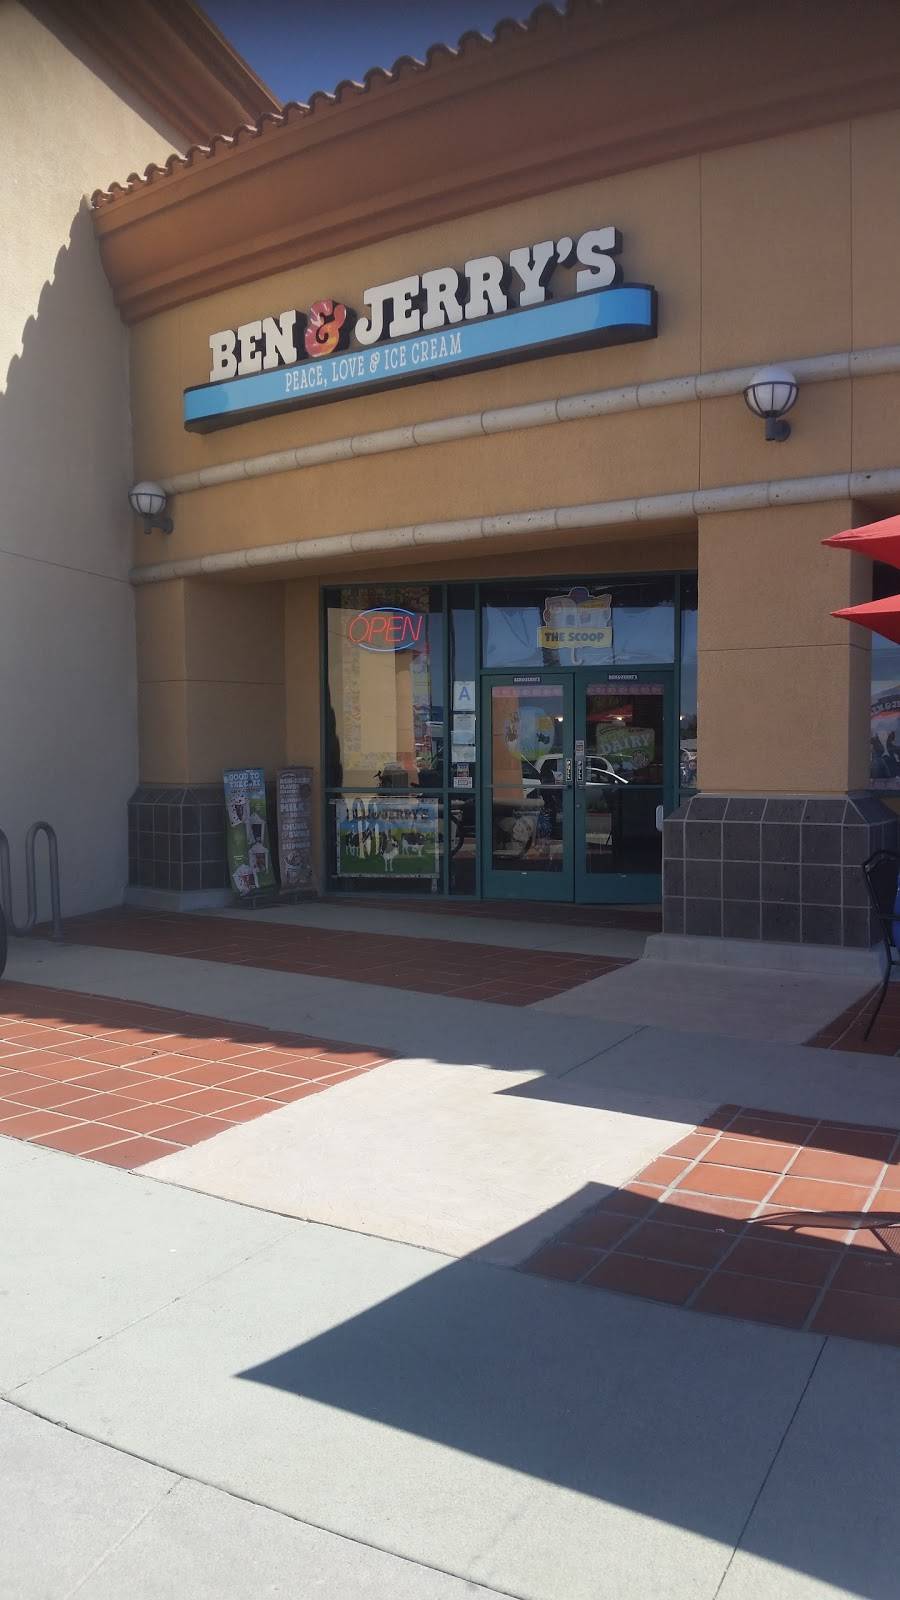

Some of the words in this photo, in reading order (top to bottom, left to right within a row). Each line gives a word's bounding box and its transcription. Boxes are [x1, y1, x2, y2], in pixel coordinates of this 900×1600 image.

[209, 309, 298, 382] BEN
[304, 297, 347, 357] &
[354, 226, 617, 345] JERRY'S
[285, 364, 328, 393] PEACE,
[332, 357, 366, 383] LOVE
[369, 351, 381, 373] &
[384, 345, 407, 370] ICE
[411, 333, 463, 364] CREAM
[349, 615, 423, 643] OPEN
[544, 631, 566, 642] THE
[568, 631, 605, 642] SCOOP
[458, 686, 471, 701] A
